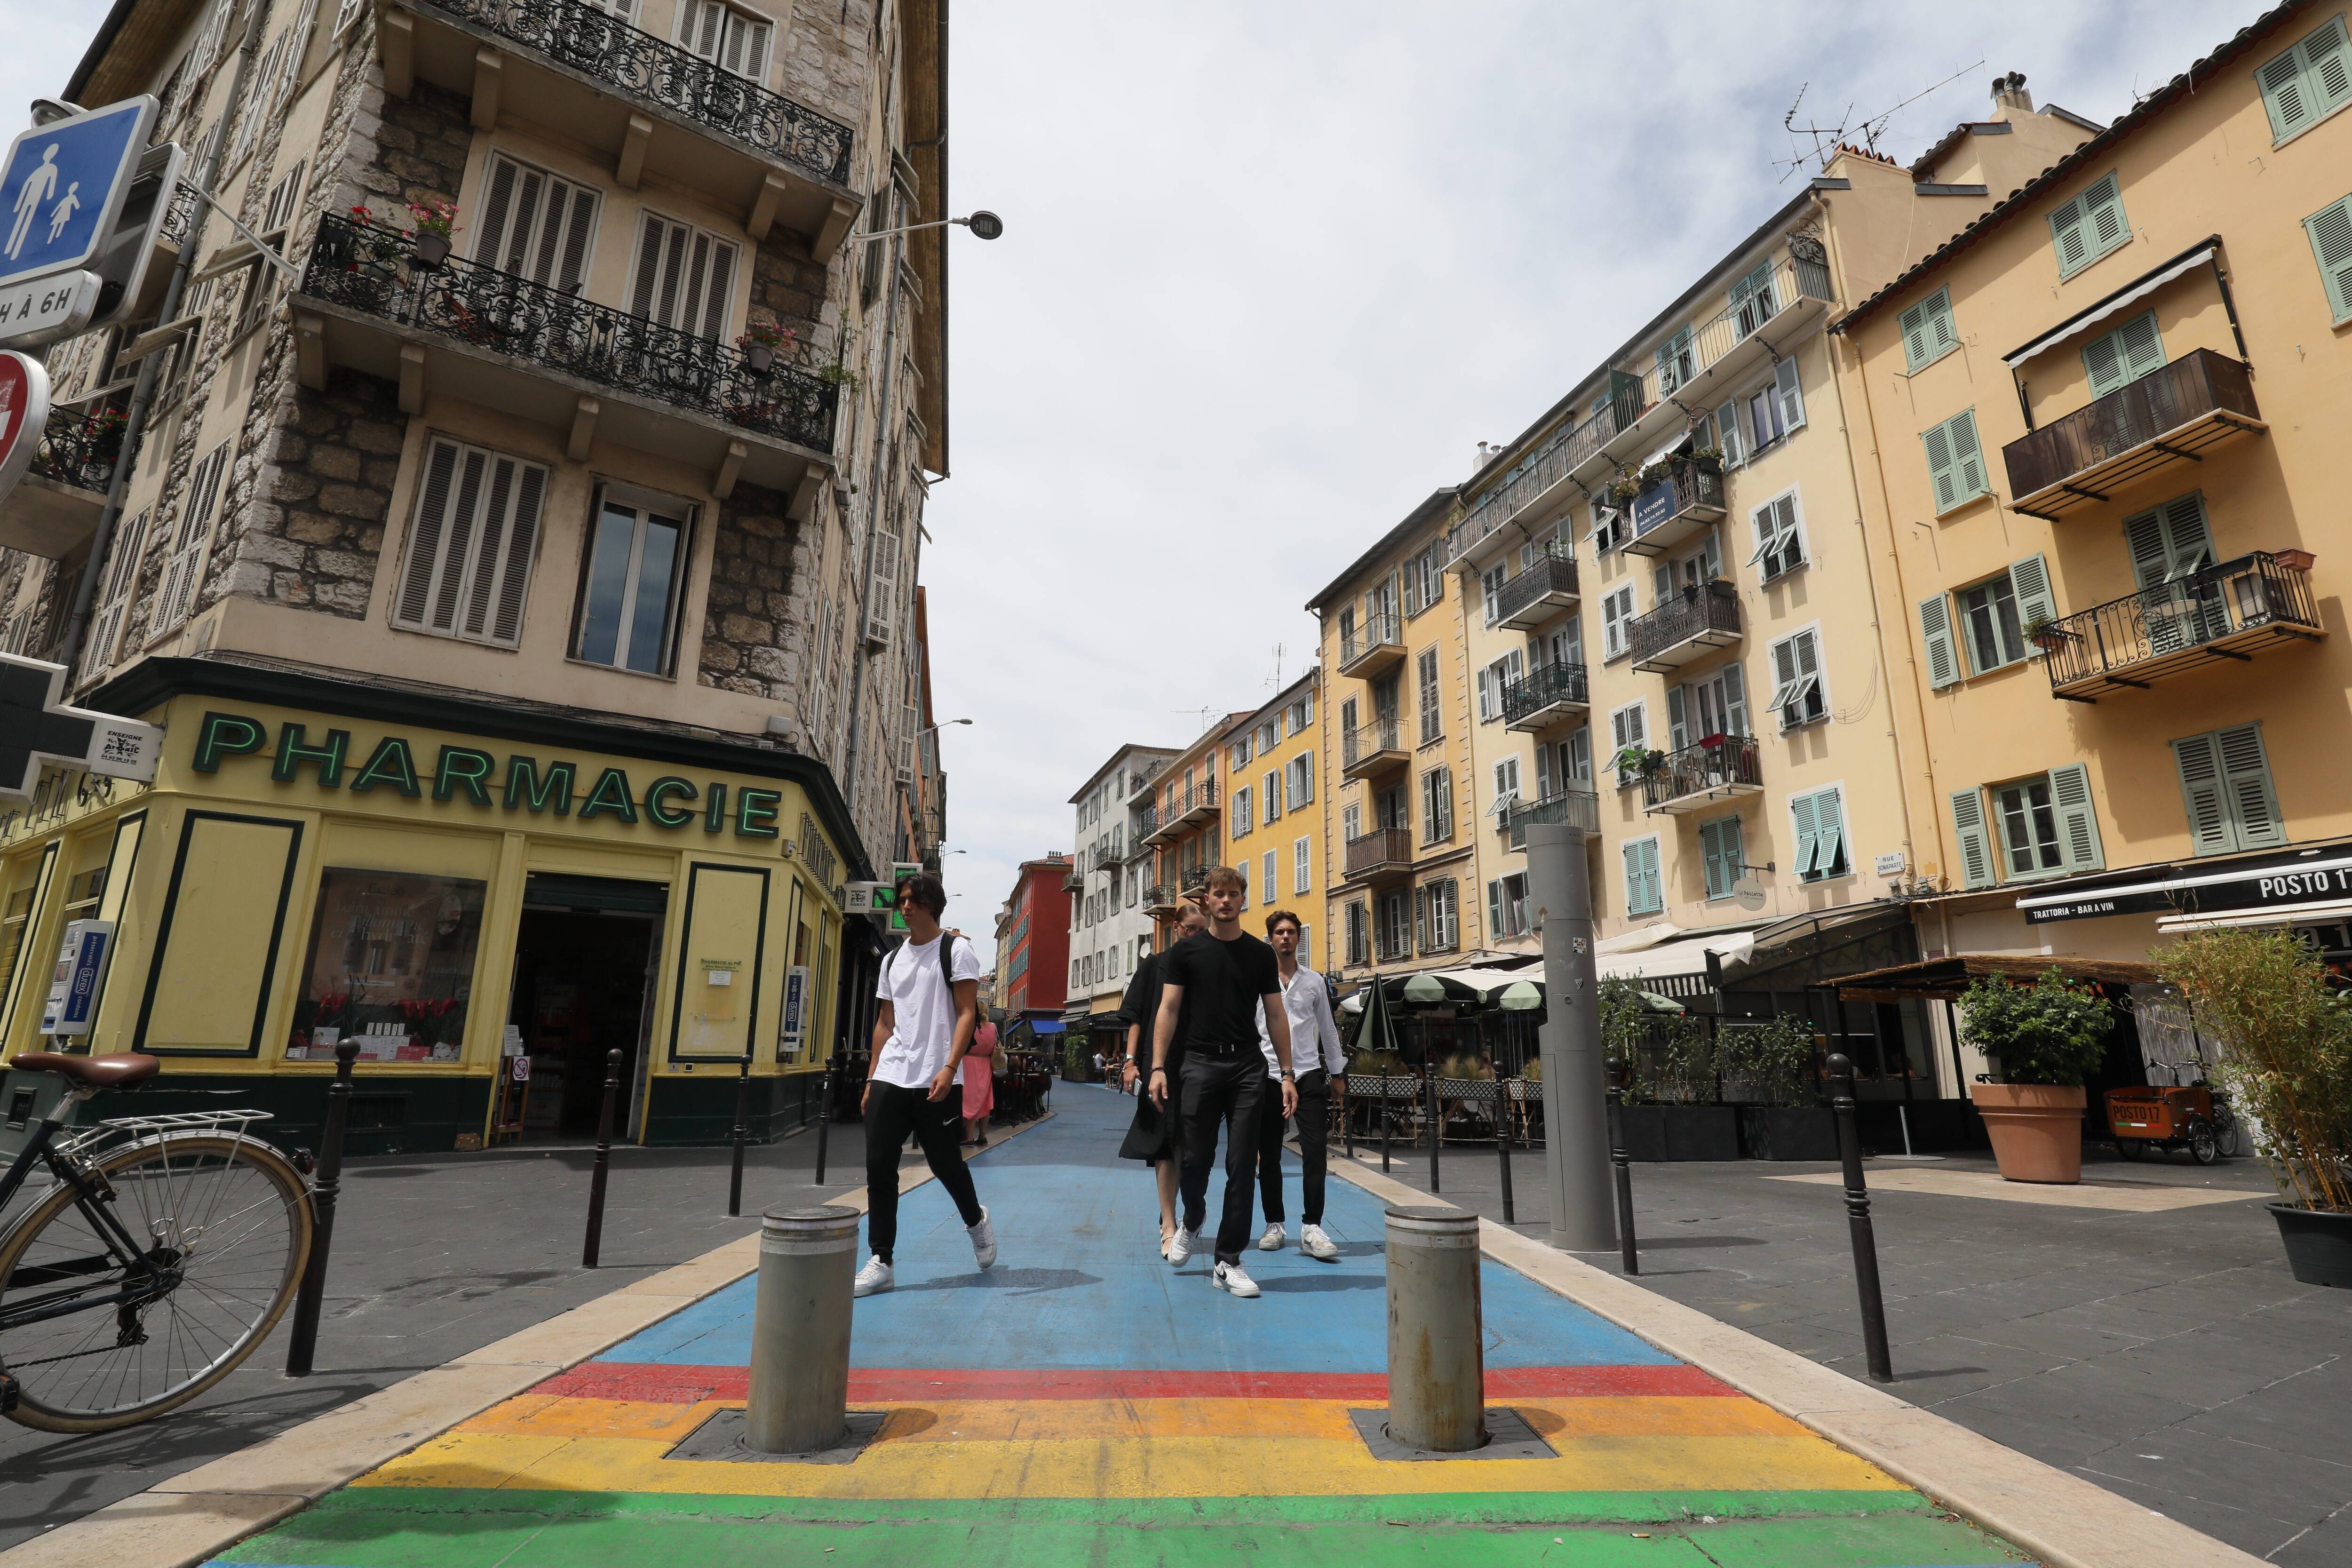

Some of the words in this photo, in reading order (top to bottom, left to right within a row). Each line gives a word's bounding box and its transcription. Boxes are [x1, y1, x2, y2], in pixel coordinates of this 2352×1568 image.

[16, 294, 32, 320] À
[40, 287, 72, 314] 6H
[1644, 497, 1665, 514] VENDRE
[107, 731, 143, 741] ENSEIGNE
[191, 711, 782, 839] PHARMACIE
[1877, 862, 1902, 871] BONAPARTE
[2260, 871, 2329, 898] POSTO
[2033, 907, 2070, 919] TRATTORIA
[2077, 905, 2093, 914] BAR
[2100, 902, 2114, 911] VIN
[86, 936, 97, 966] préservatifs
[79, 970, 92, 991] durex
[73, 996, 82, 1018] condoms
